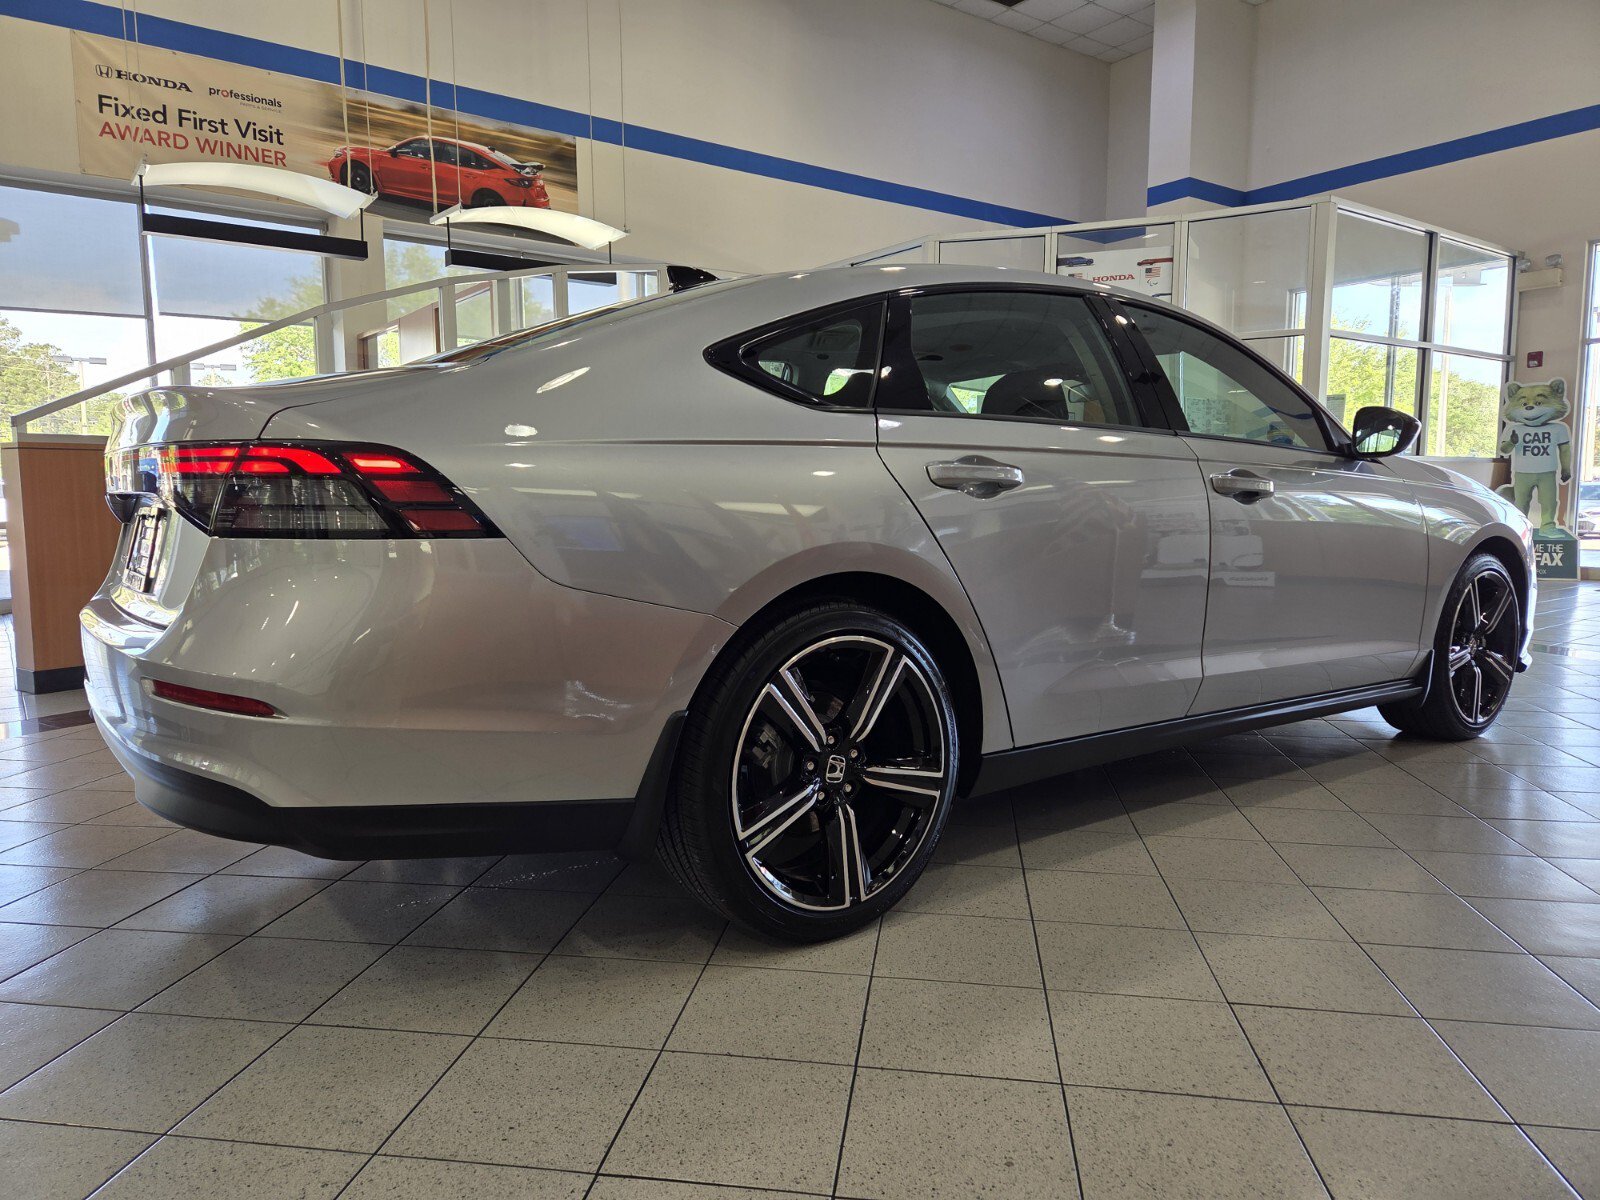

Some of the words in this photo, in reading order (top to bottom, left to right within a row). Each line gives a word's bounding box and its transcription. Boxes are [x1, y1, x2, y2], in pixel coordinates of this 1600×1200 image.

[115, 69, 193, 93] HONDA
[208, 87, 282, 108] professionals
[98, 94, 167, 125] Fixed
[177, 108, 229, 136] First
[234, 118, 284, 146] Visit
[98, 121, 189, 150] AWARD
[195, 136, 288, 168] WINNER
[1093, 274, 1135, 282] HONDA
[1522, 432, 1551, 444] CAR
[1522, 445, 1550, 457] FOX
[1546, 543, 1564, 553] THE
